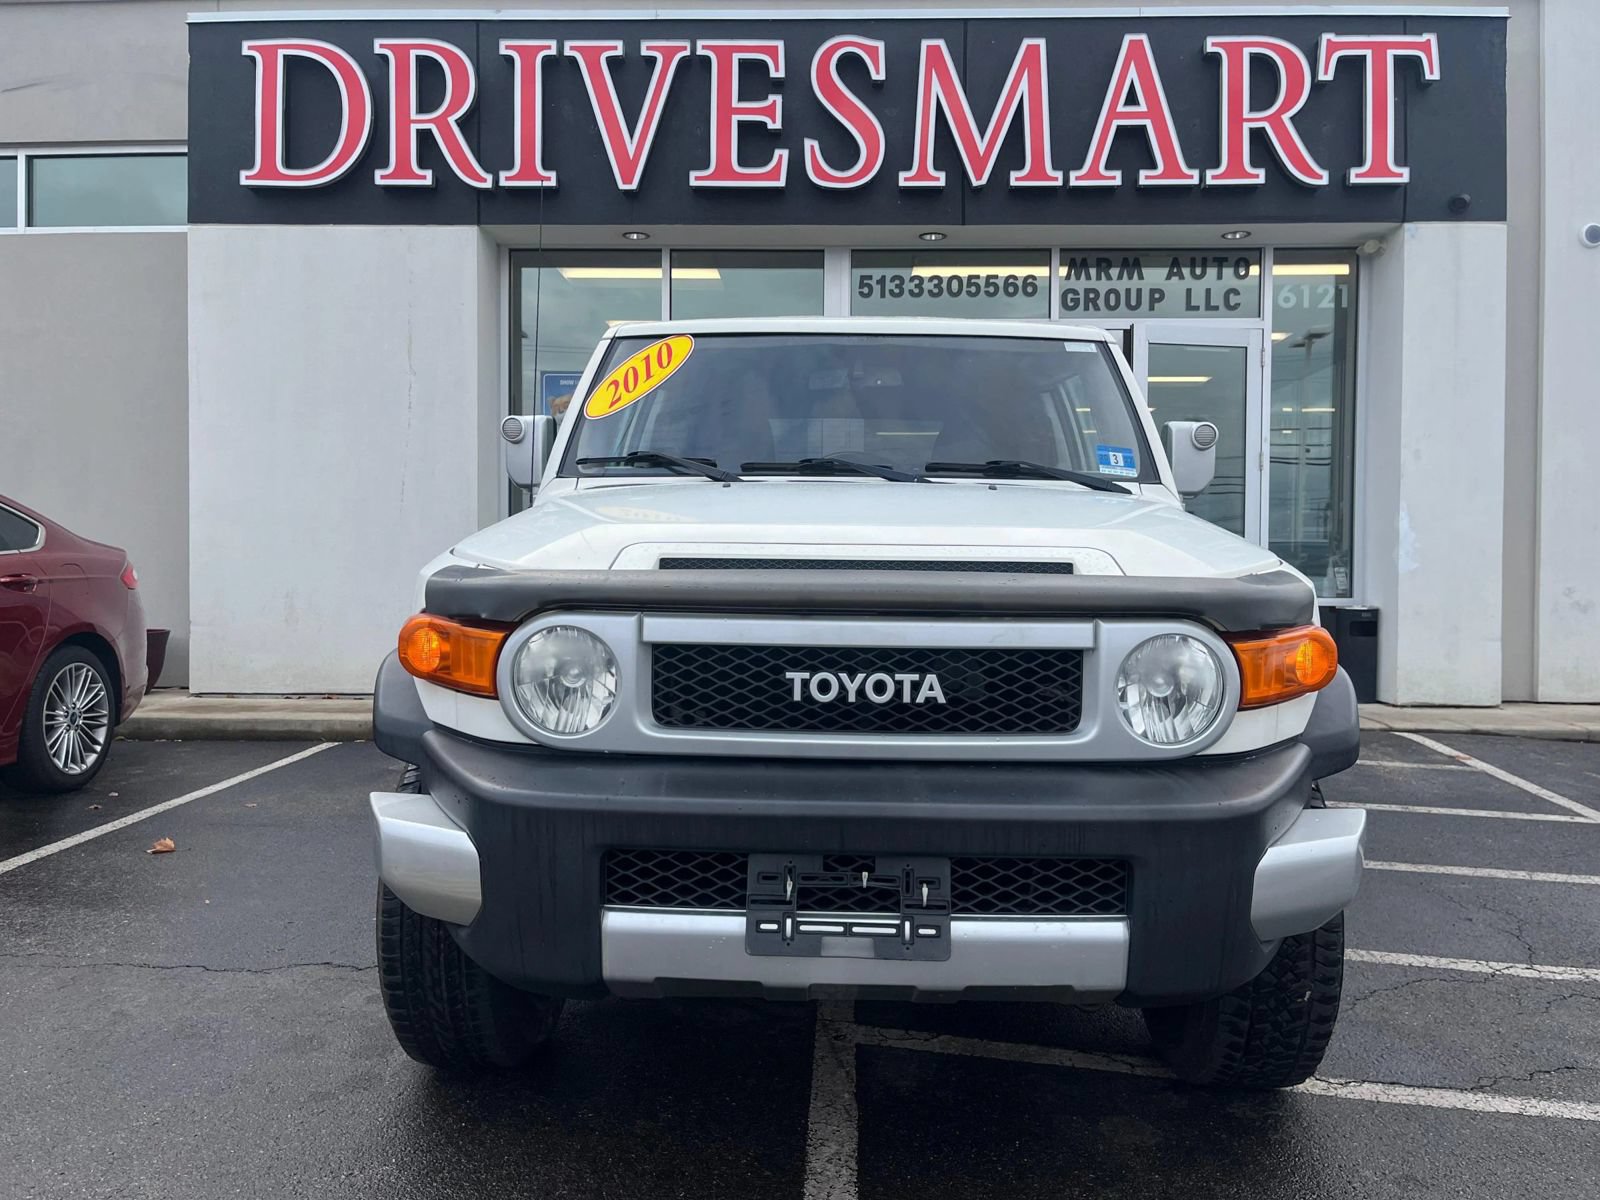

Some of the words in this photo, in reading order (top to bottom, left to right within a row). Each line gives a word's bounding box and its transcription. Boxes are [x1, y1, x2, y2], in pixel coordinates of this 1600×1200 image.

[239, 34, 1440, 190] DRIVESMART
[1065, 257, 1145, 281] MRM
[1165, 257, 1251, 281] AUTO
[858, 274, 1038, 299] 5133305566
[1277, 284, 1348, 309] 6121
[1061, 287, 1165, 311] GROUP
[1185, 287, 1242, 312] LLC
[606, 342, 672, 409] 2010
[785, 671, 947, 704] TOYOTA
